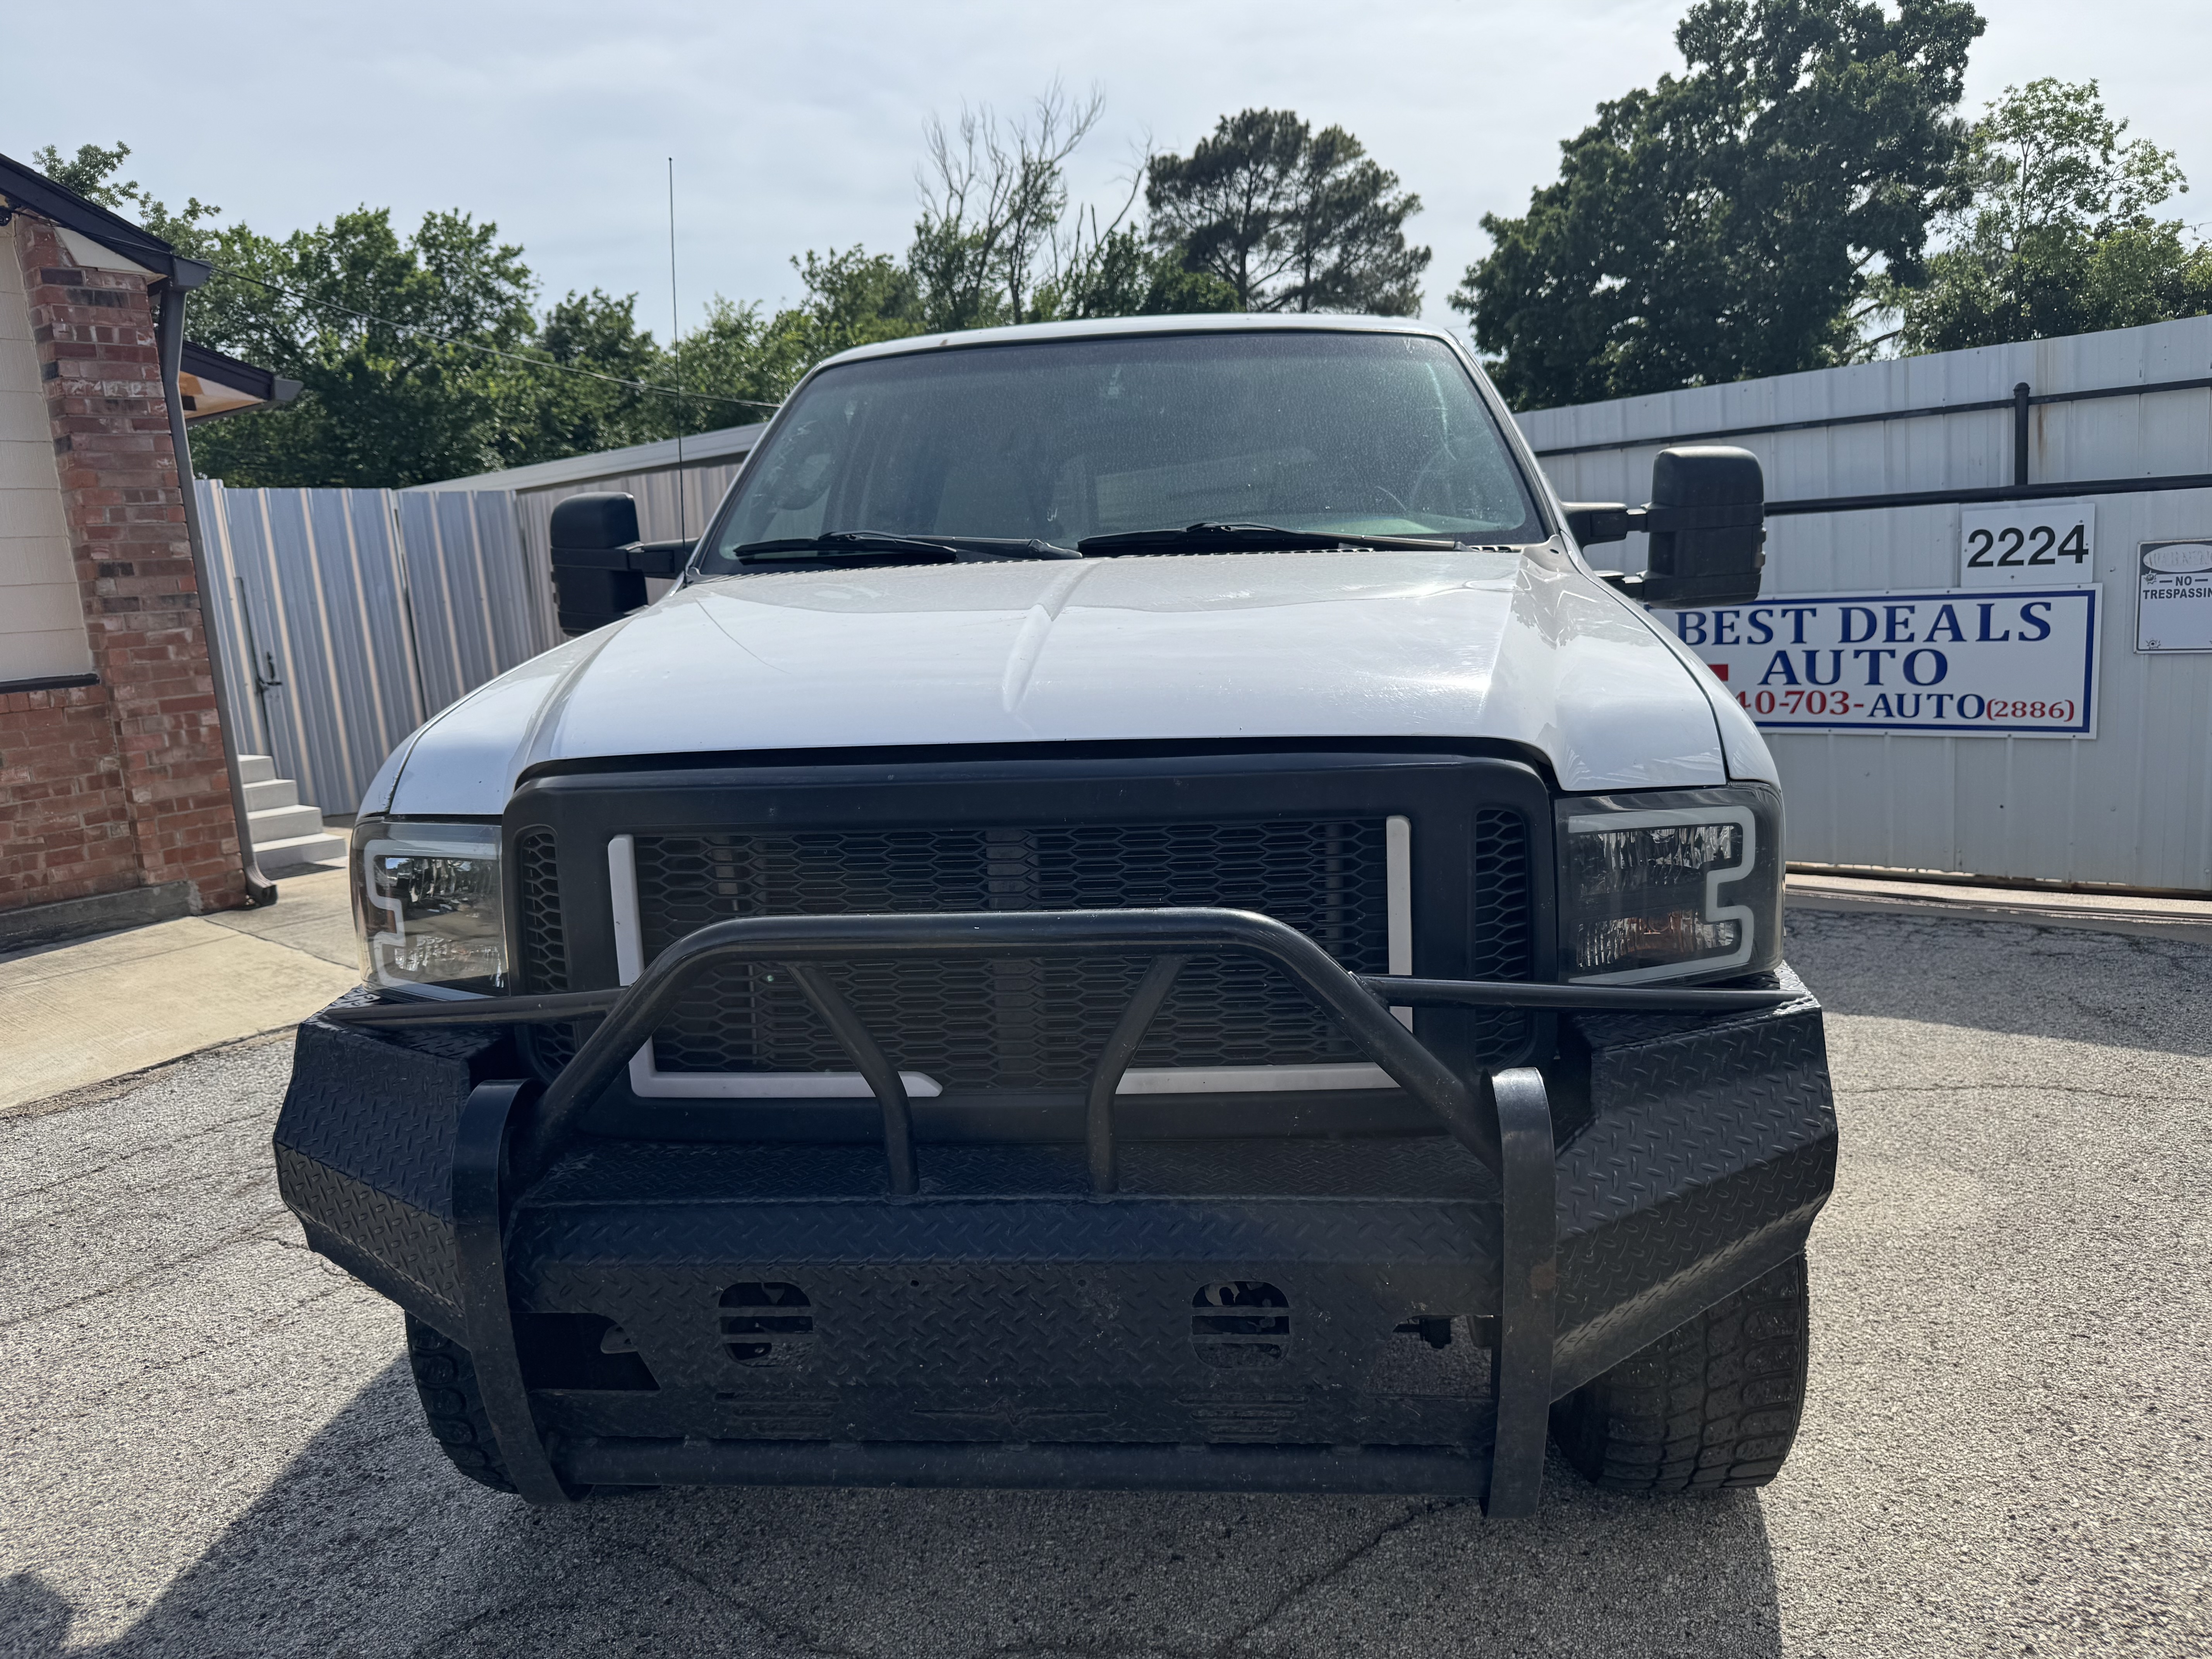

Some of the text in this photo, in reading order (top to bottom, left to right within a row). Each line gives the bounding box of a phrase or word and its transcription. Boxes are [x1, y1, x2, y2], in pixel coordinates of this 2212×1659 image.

[1967, 524, 2089, 568] 2224
[2175, 576, 2192, 586] NO
[1675, 602, 2052, 646] BEST DEALS
[1757, 649, 1948, 686] AUTO
